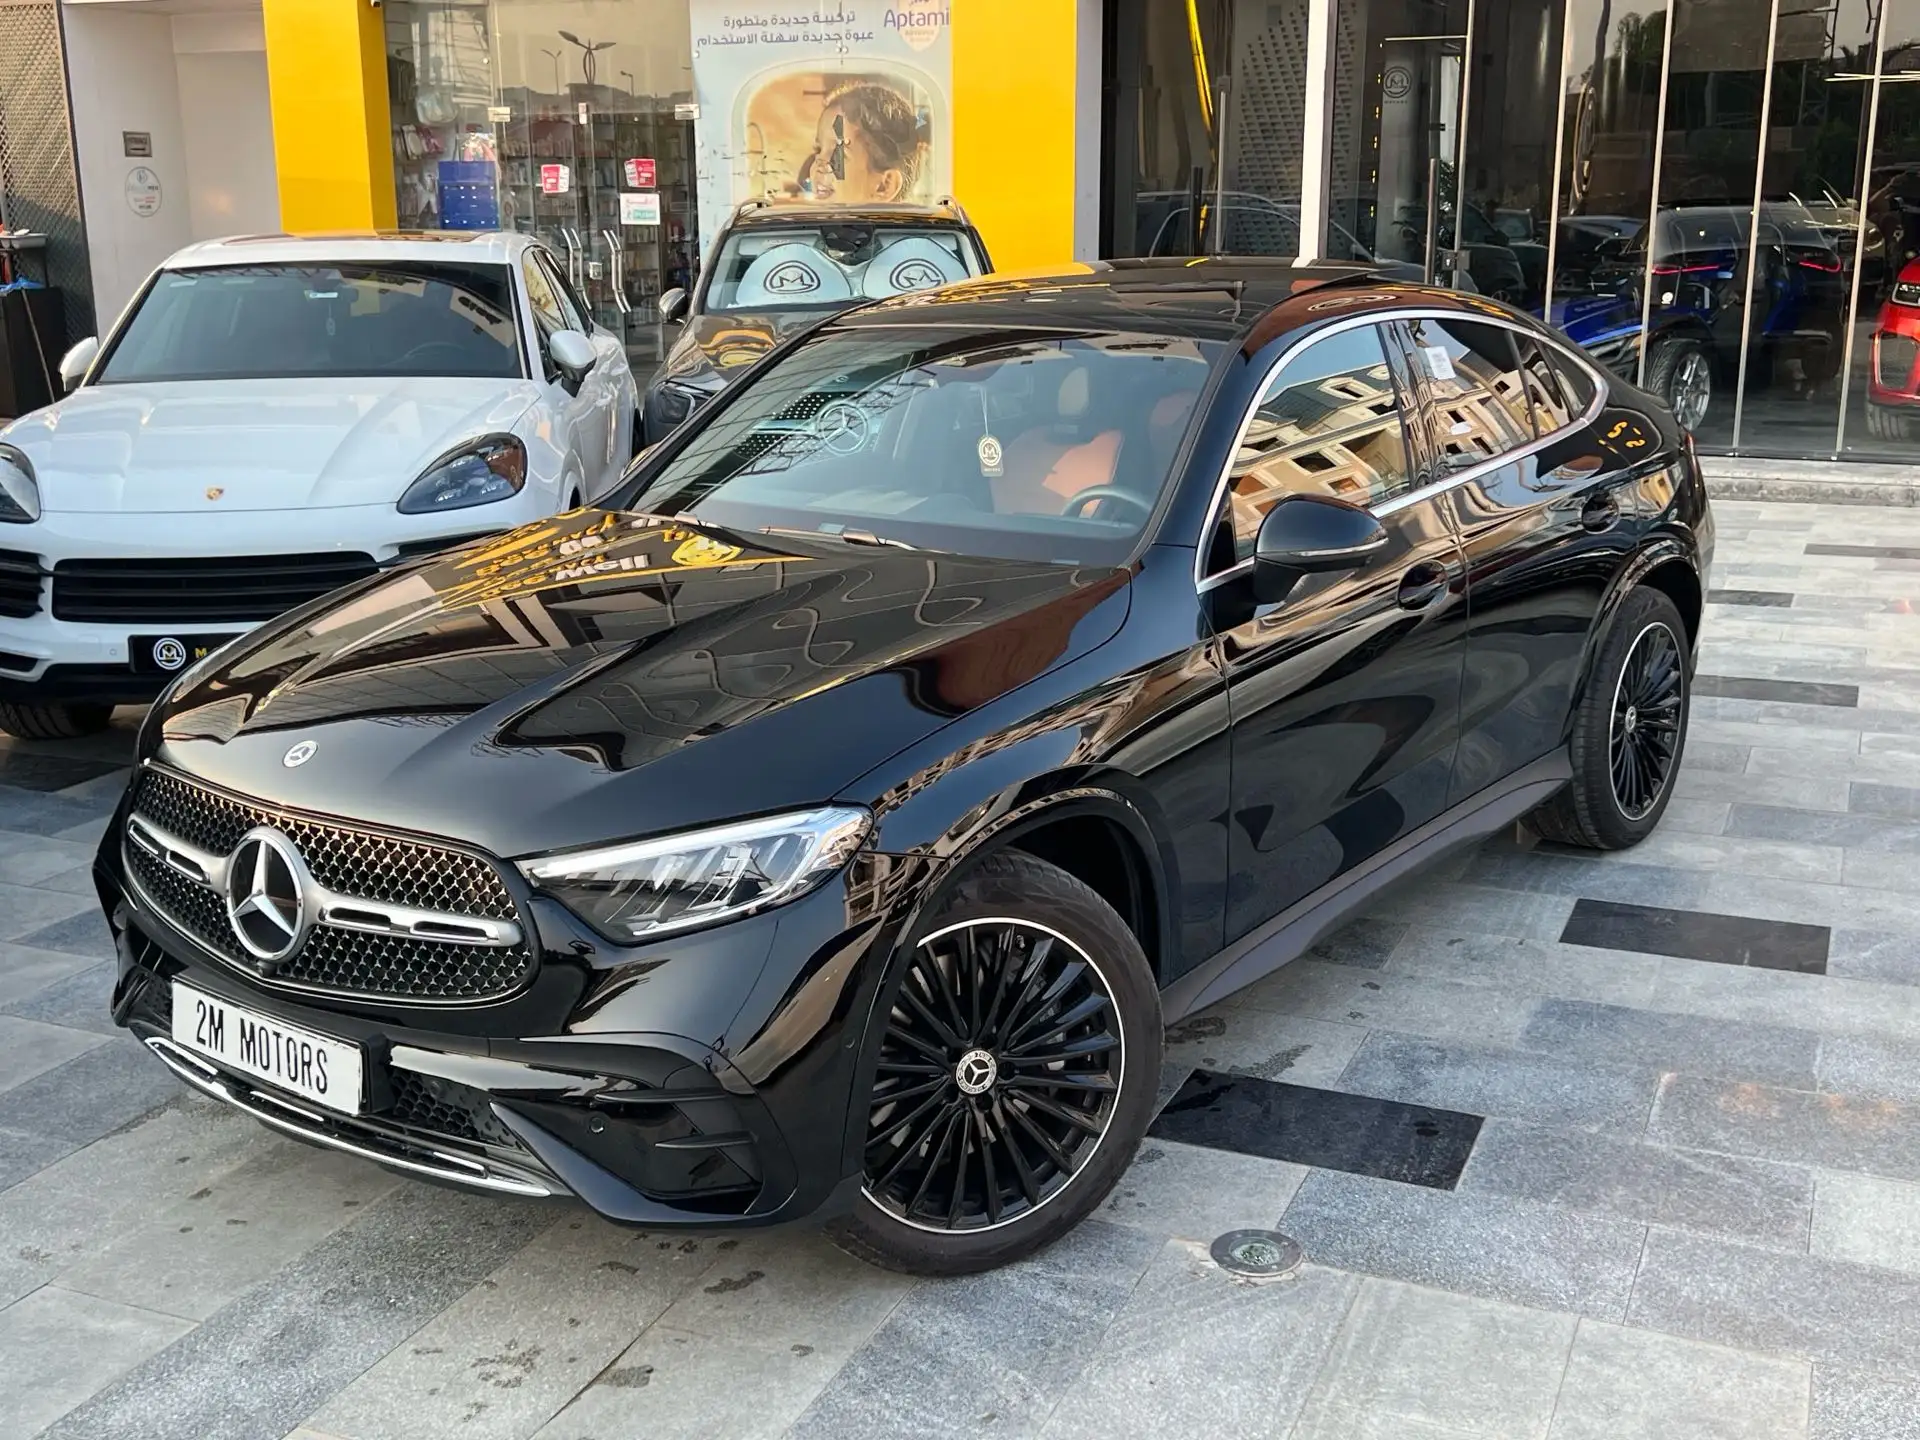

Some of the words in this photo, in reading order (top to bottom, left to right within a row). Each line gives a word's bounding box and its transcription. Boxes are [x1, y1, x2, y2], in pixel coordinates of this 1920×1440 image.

[723, 15, 768, 29] متطورة
[771, 14, 809, 28] جديدة
[812, 10, 856, 26] تركيبة
[883, 7, 951, 32] Aptami
[696, 32, 758, 47] الاستخدام
[760, 31, 799, 43] سهلة
[802, 30, 843, 44] جديدة
[844, 29, 874, 43] عبوة
[196, 999, 224, 1053] 2M
[240, 1017, 328, 1094] MOTORS
